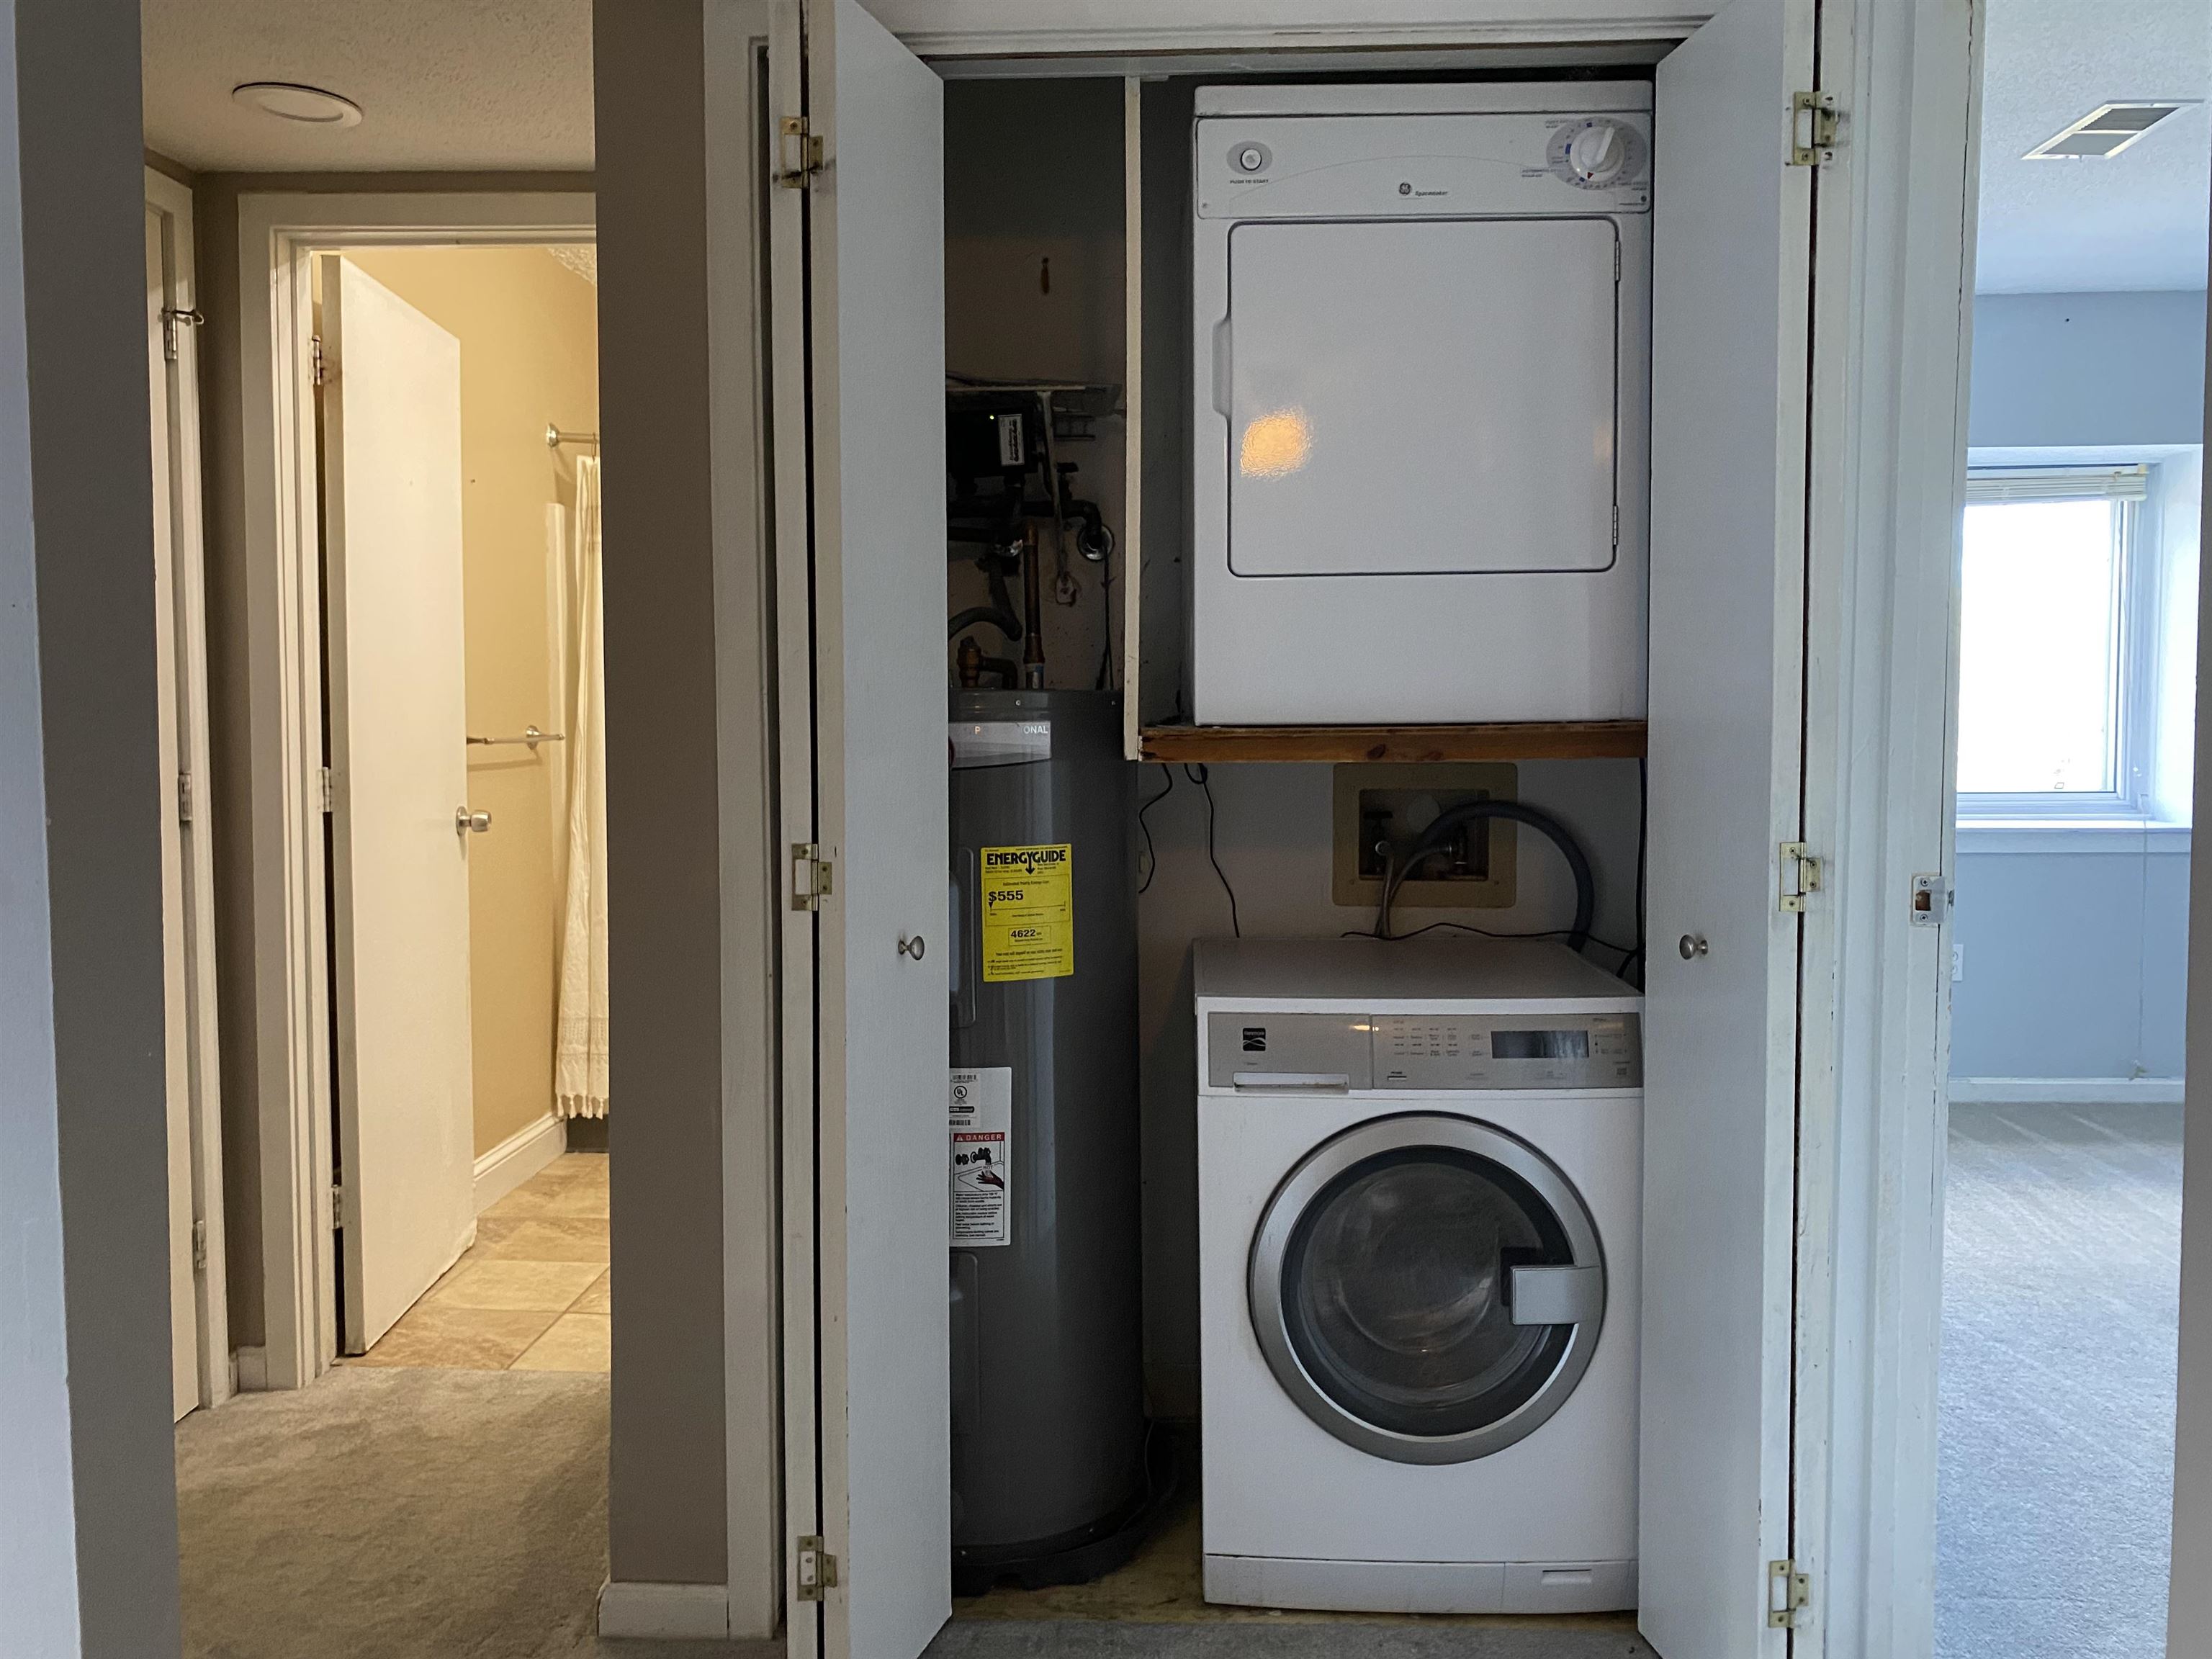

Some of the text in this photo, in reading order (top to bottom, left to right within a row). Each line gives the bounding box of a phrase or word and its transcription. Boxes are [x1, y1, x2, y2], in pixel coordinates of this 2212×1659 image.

[986, 849, 1066, 866] ENERGYGUIDE
[988, 890, 1023, 902] $555
[1010, 929, 1035, 938] 4622
